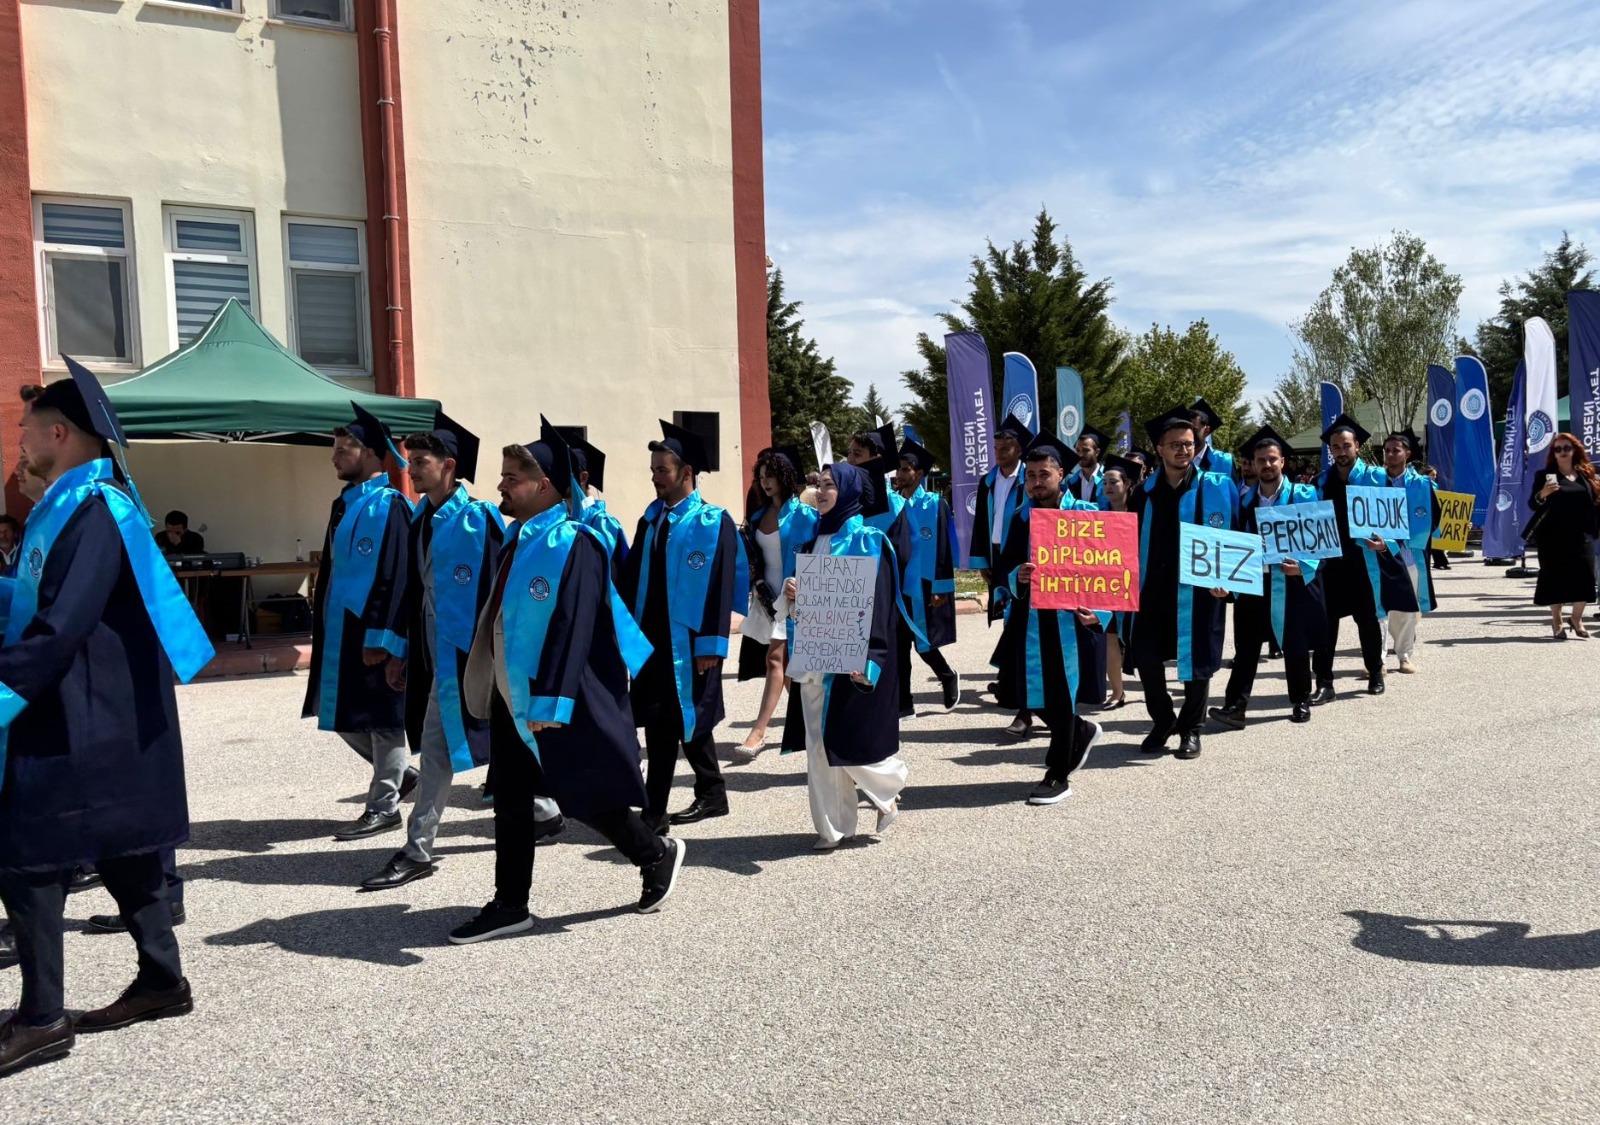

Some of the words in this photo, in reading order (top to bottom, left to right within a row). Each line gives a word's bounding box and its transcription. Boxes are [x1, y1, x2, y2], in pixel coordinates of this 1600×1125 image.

[1352, 496, 1408, 530] OLDUK
[1439, 498, 1472, 520] YARIN
[1057, 518, 1106, 538] BİZE
[1260, 512, 1340, 555] PERİŞAN
[802, 555, 865, 576] ZİRAAT
[1037, 545, 1122, 566] DİPLOMA
[1191, 538, 1255, 584] BİZ
[1040, 569, 1131, 600] İHTİYAÇ!
[797, 594, 831, 608] OLSAM
[834, 595, 850, 609] NE
[851, 595, 873, 610] OLUR
